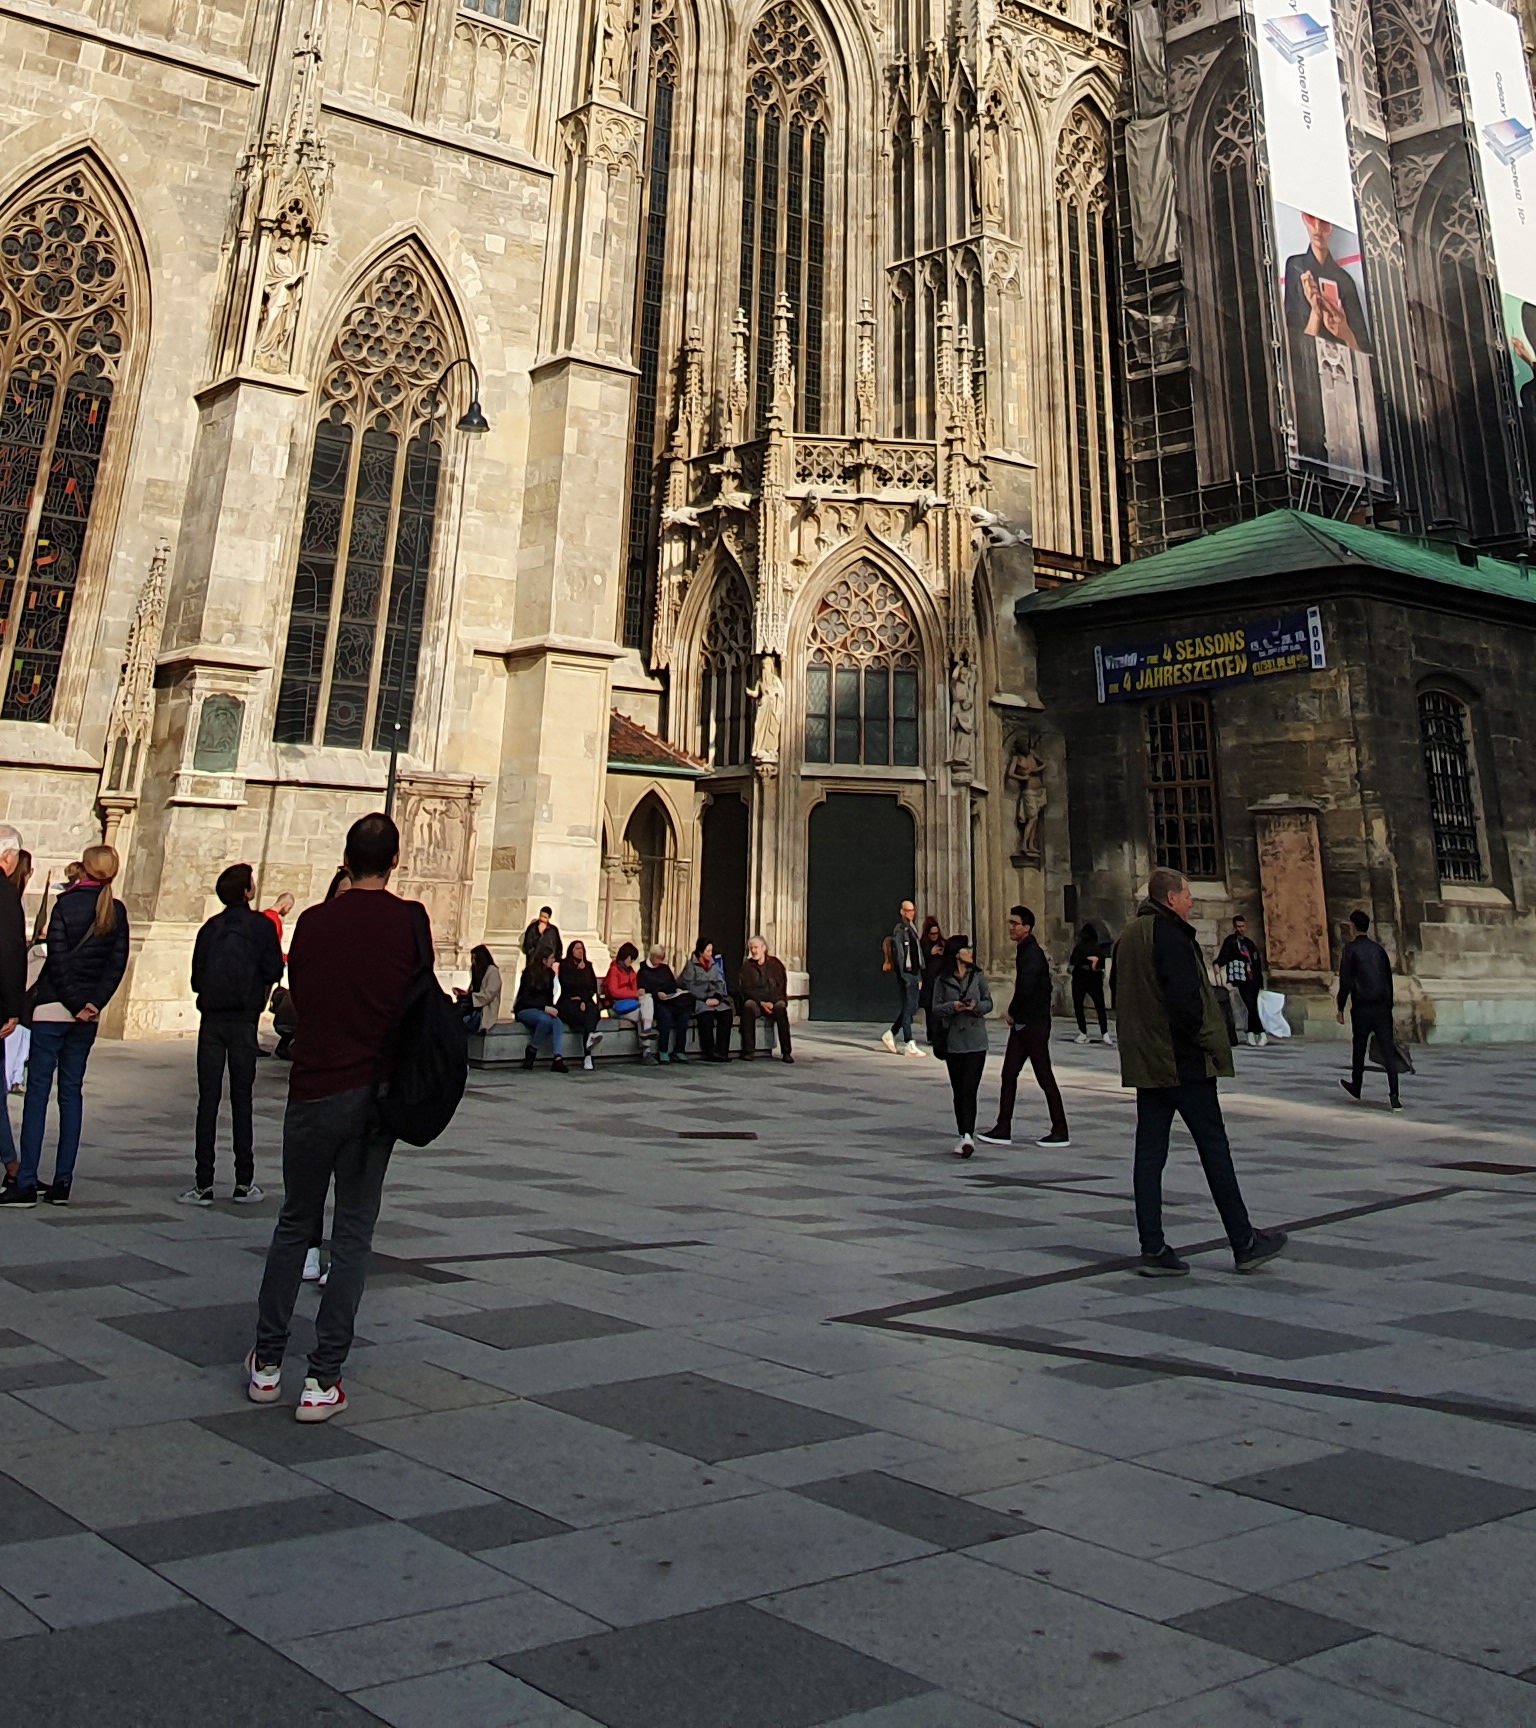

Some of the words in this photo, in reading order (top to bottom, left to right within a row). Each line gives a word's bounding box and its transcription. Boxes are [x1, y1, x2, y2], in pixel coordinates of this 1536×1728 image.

[1495, 71, 1508, 118] Galaxy
[1162, 643, 1173, 663] 4
[1175, 629, 1246, 661] SEASONS
[1122, 671, 1132, 693] 4
[1135, 653, 1248, 691] JAHRESZEITEN
